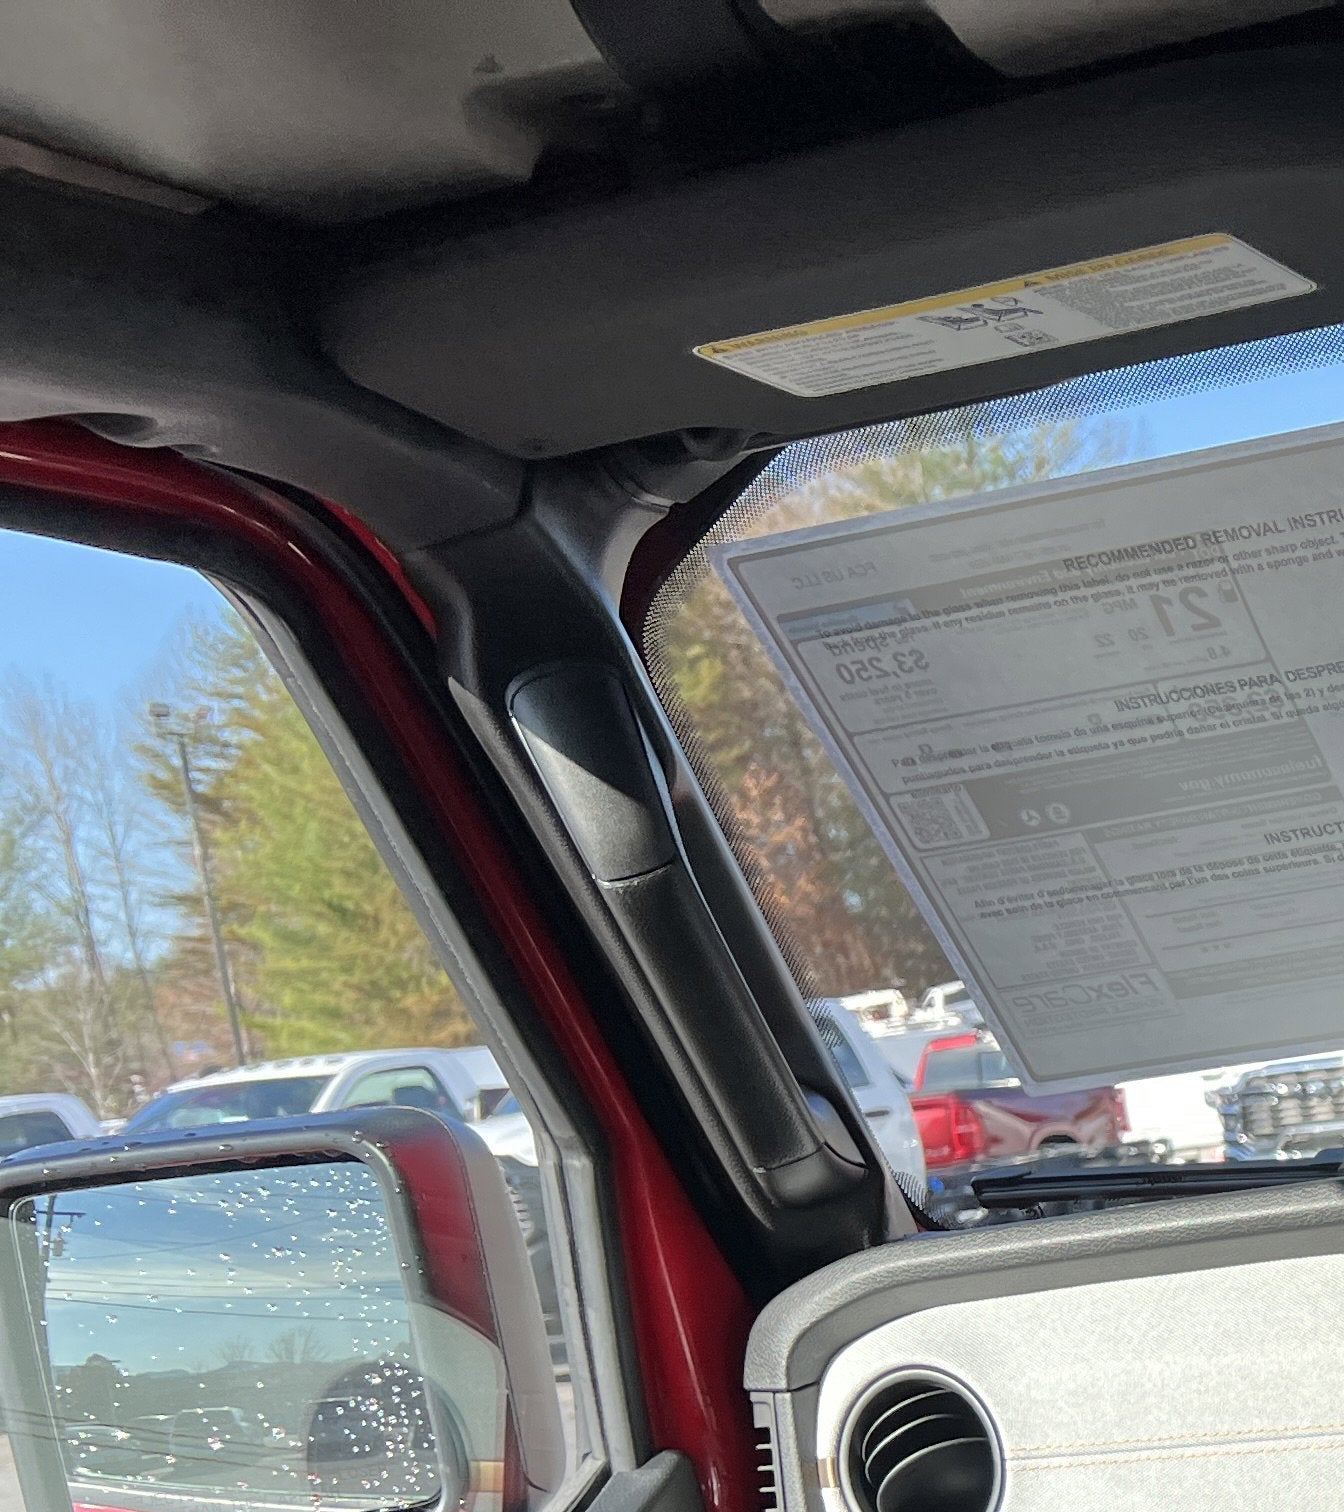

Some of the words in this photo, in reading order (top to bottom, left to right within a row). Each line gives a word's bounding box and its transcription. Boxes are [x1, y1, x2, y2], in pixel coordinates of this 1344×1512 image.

[1062, 534, 1198, 573] RECOMMENDED
[1199, 520, 1285, 547] REMOVAL
[1264, 542, 1297, 557] sharp
[1113, 679, 1238, 713] INSTRUCCIONES
[1238, 672, 1283, 691] PARA
